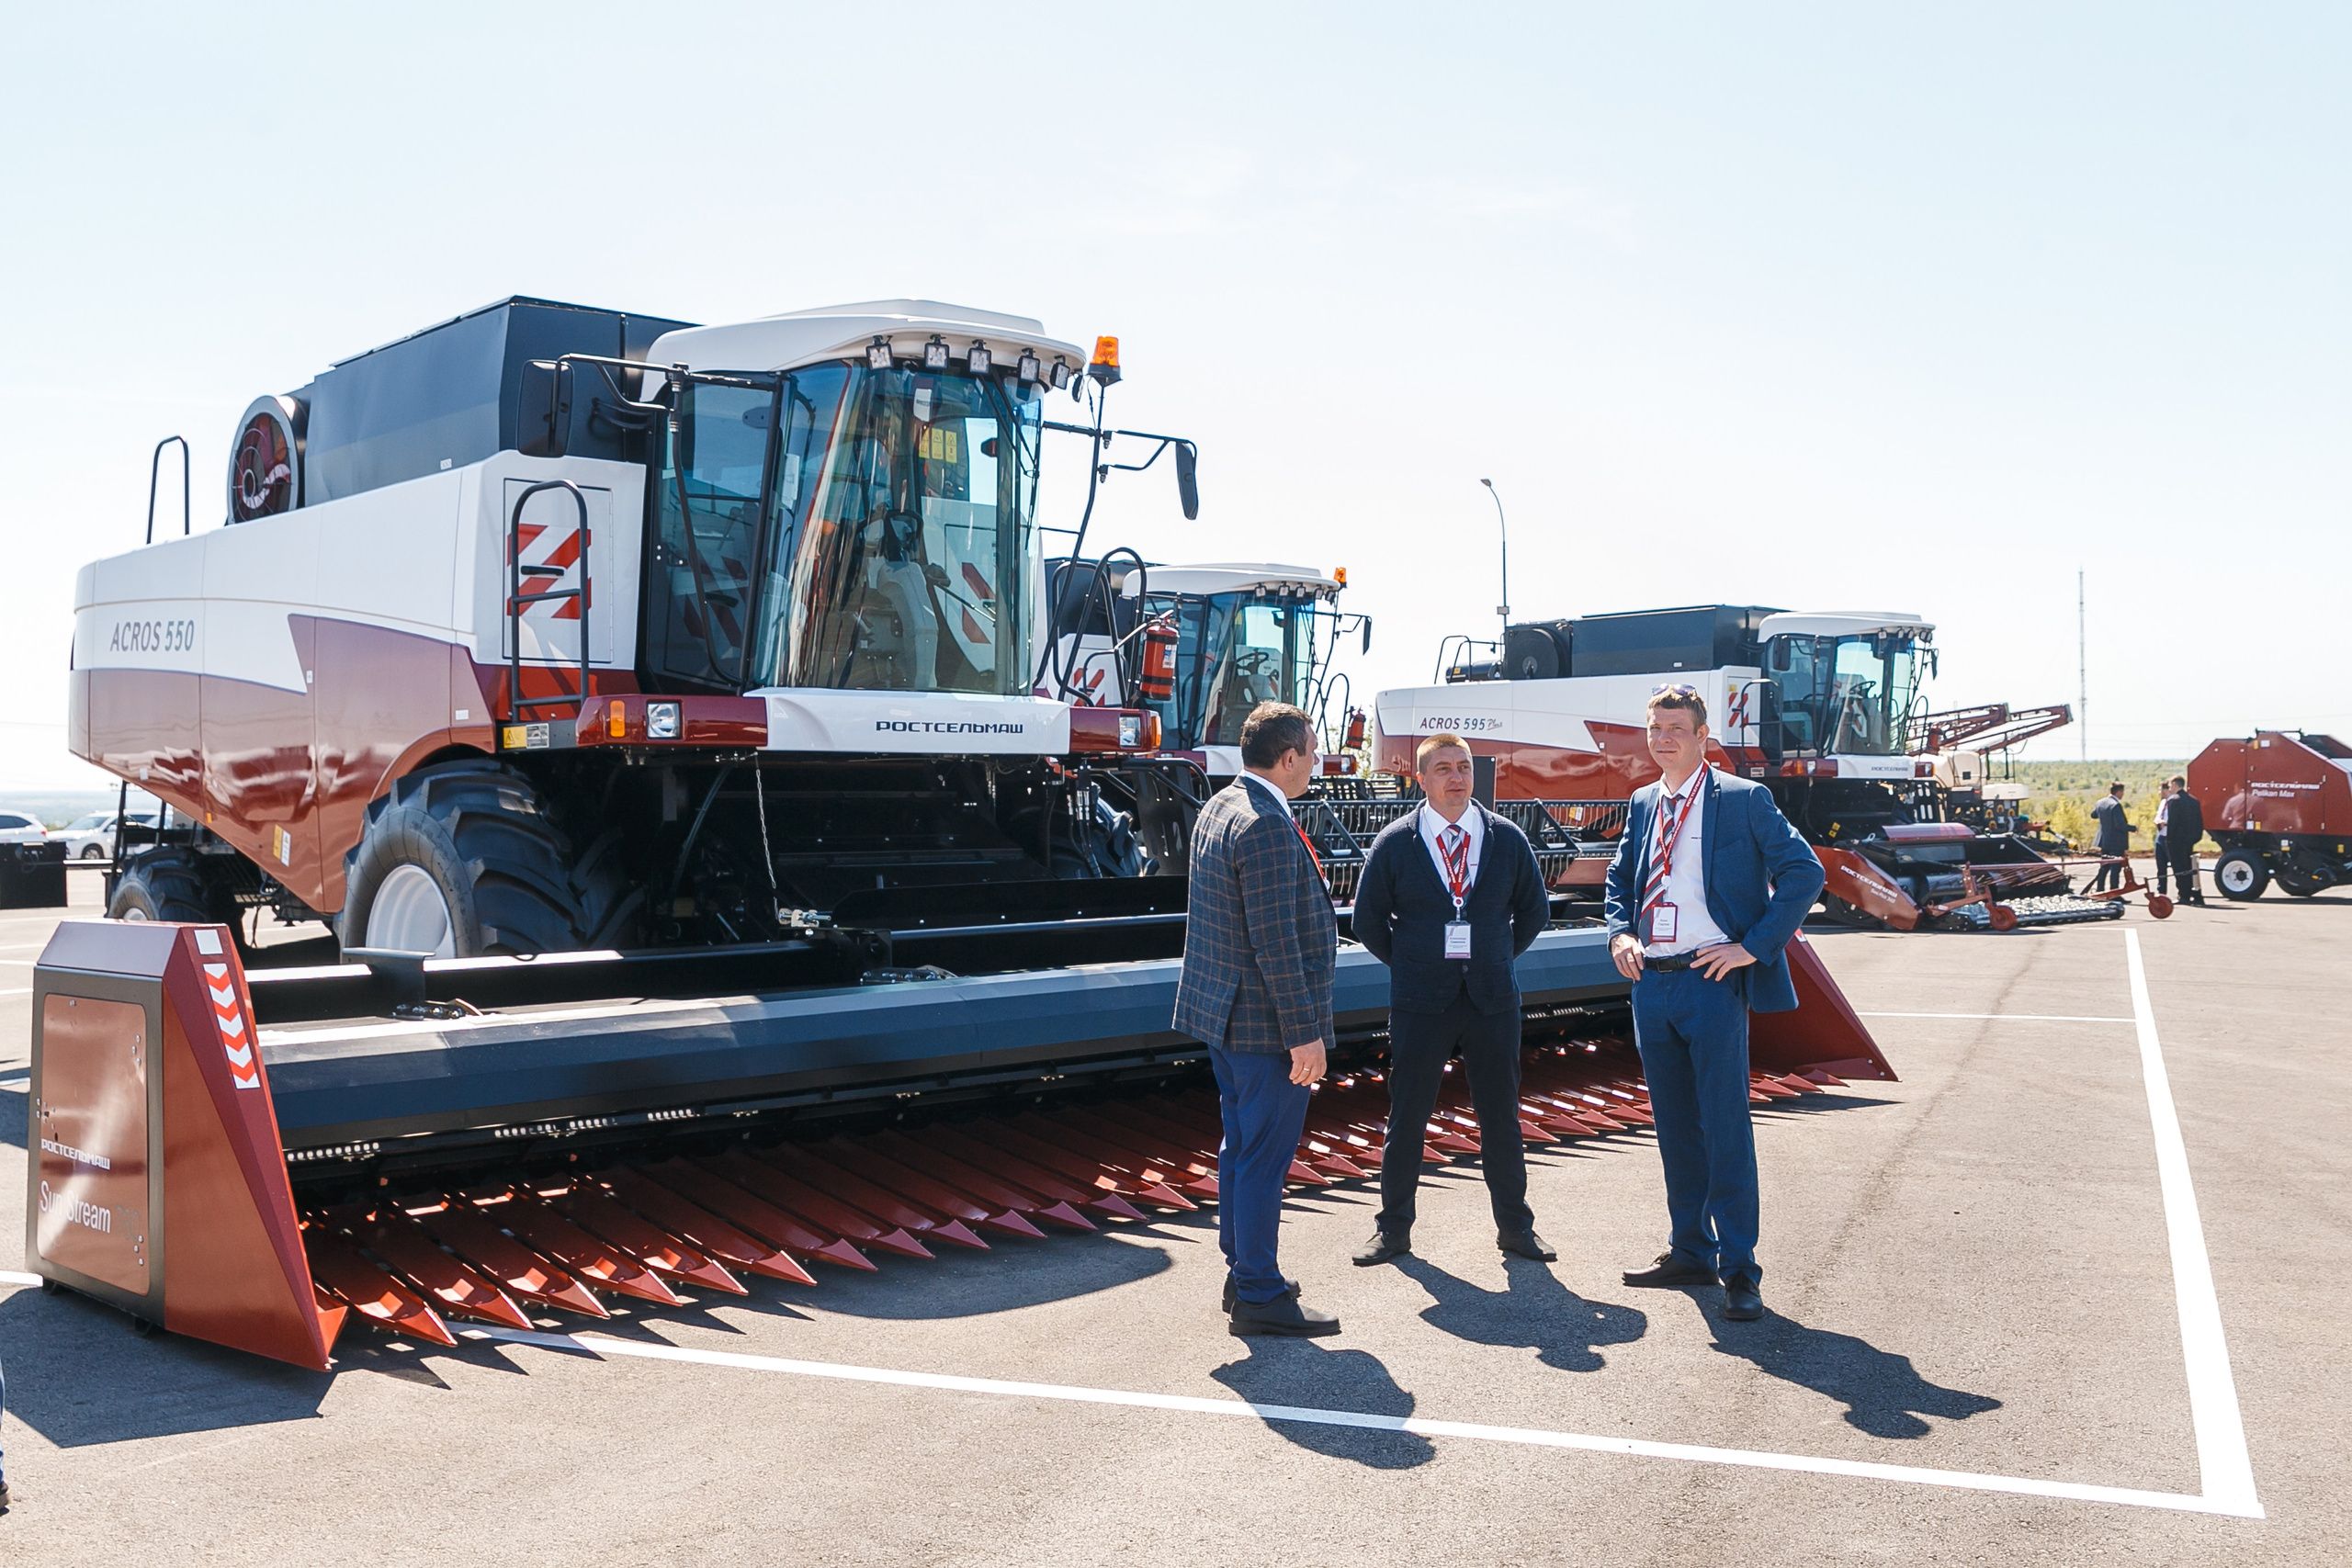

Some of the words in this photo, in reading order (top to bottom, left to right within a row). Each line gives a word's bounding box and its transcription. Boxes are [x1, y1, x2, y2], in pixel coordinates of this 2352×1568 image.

[109, 621, 162, 652] ACROS
[164, 619, 195, 652] 550
[876, 721, 1023, 734] РОСТСЕЛЬМАШ
[1419, 716, 1461, 729] ACROS
[1464, 717, 1486, 730] 595
[40, 1138, 110, 1170] РОСТСЕЛЬМАШ
[40, 1180, 63, 1217] Sun
[66, 1190, 111, 1234] Stream
